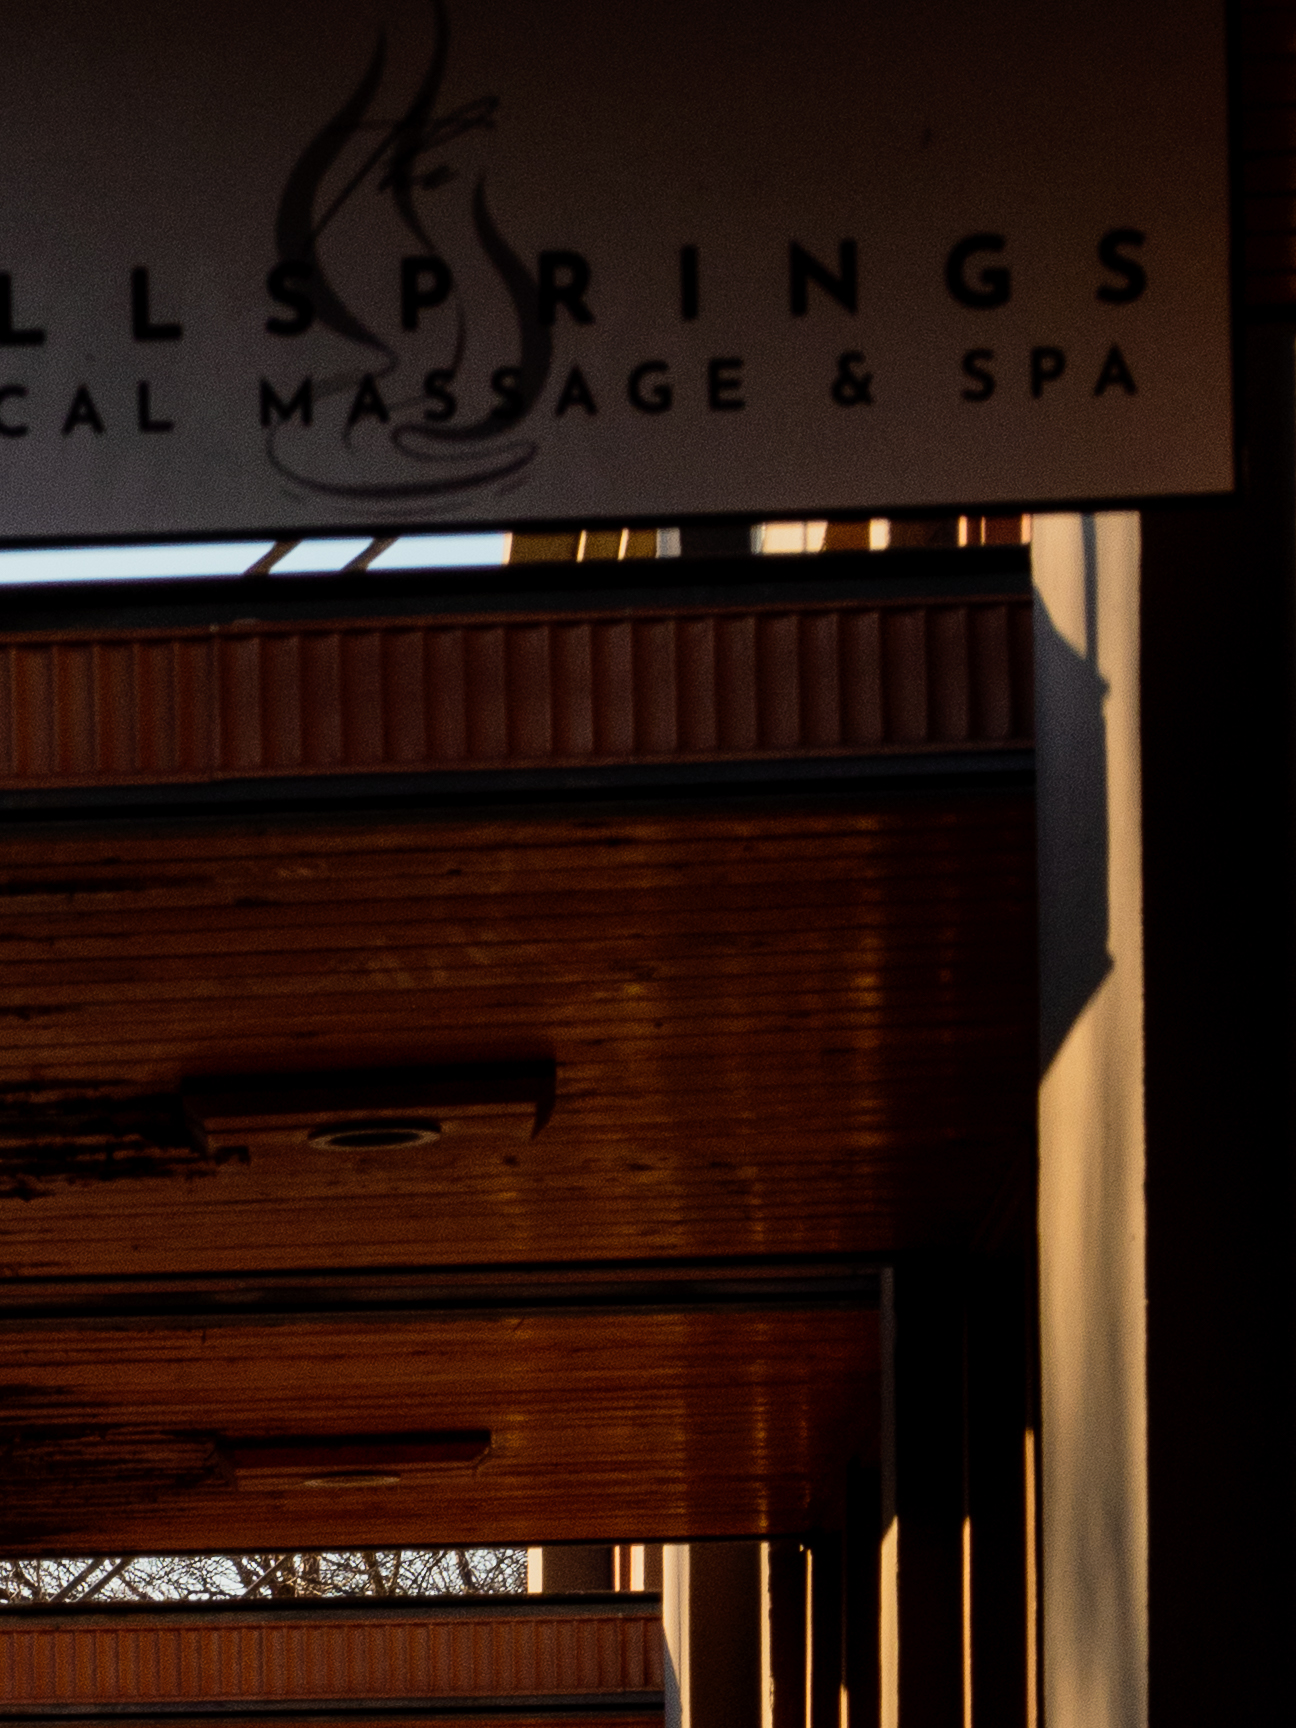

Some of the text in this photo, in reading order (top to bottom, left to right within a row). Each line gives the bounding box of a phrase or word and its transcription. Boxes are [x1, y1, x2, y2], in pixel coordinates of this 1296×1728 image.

[258, 356, 746, 429] MASSAGE
[830, 350, 873, 406] &
[961, 343, 1139, 403] SPA
